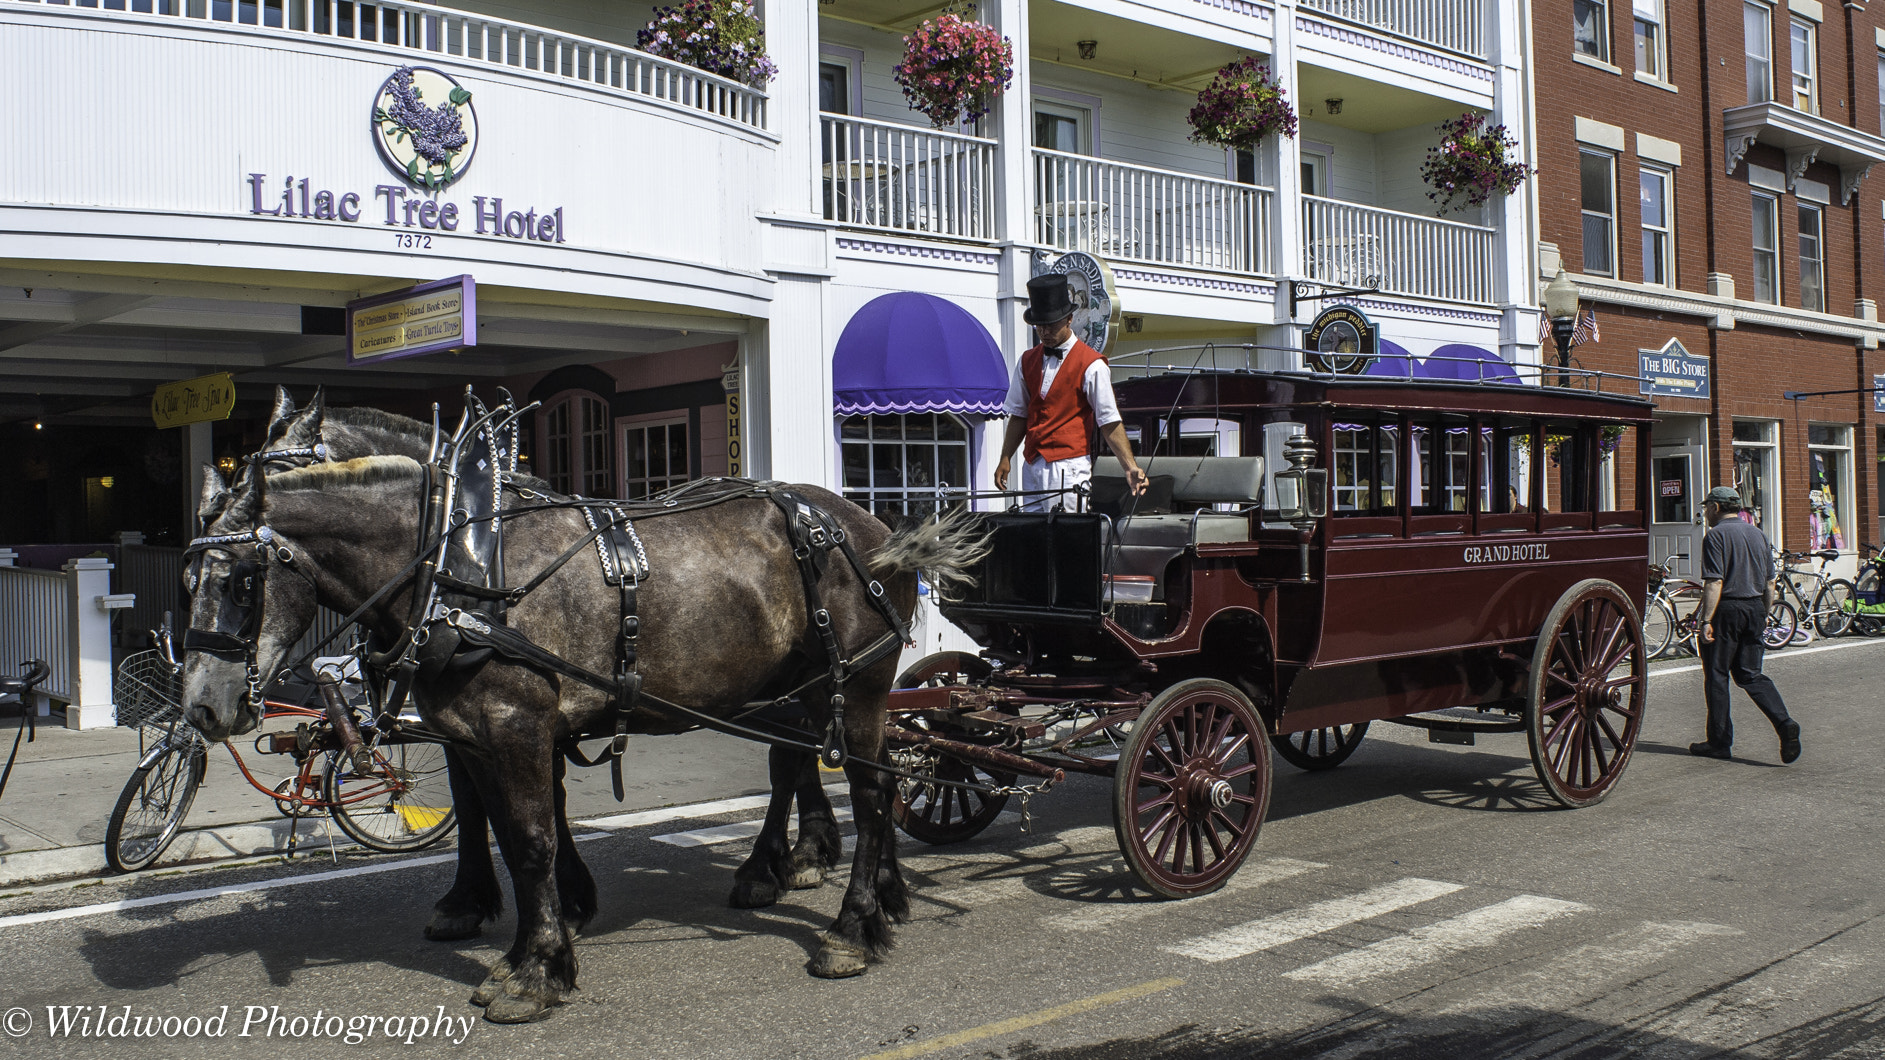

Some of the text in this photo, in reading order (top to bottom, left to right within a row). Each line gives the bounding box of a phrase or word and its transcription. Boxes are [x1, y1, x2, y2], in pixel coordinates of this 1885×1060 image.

[248, 173, 566, 244] Lilac Tree Hotel
[395, 234, 432, 249] 7372
[1080, 255, 1102, 291] SADIE
[407, 299, 456, 317] Island Book Store
[357, 311, 399, 328] The Christmas Store
[407, 321, 457, 340] Great Turtle Toys
[360, 334, 396, 349] Caricatures
[1642, 356, 1707, 377] THE BIG STORE
[184, 387, 200, 415] Tree
[202, 384, 220, 413] Spa
[1662, 485, 1680, 494] OPEN
[1463, 543, 1550, 563] GRAND HOTEL
